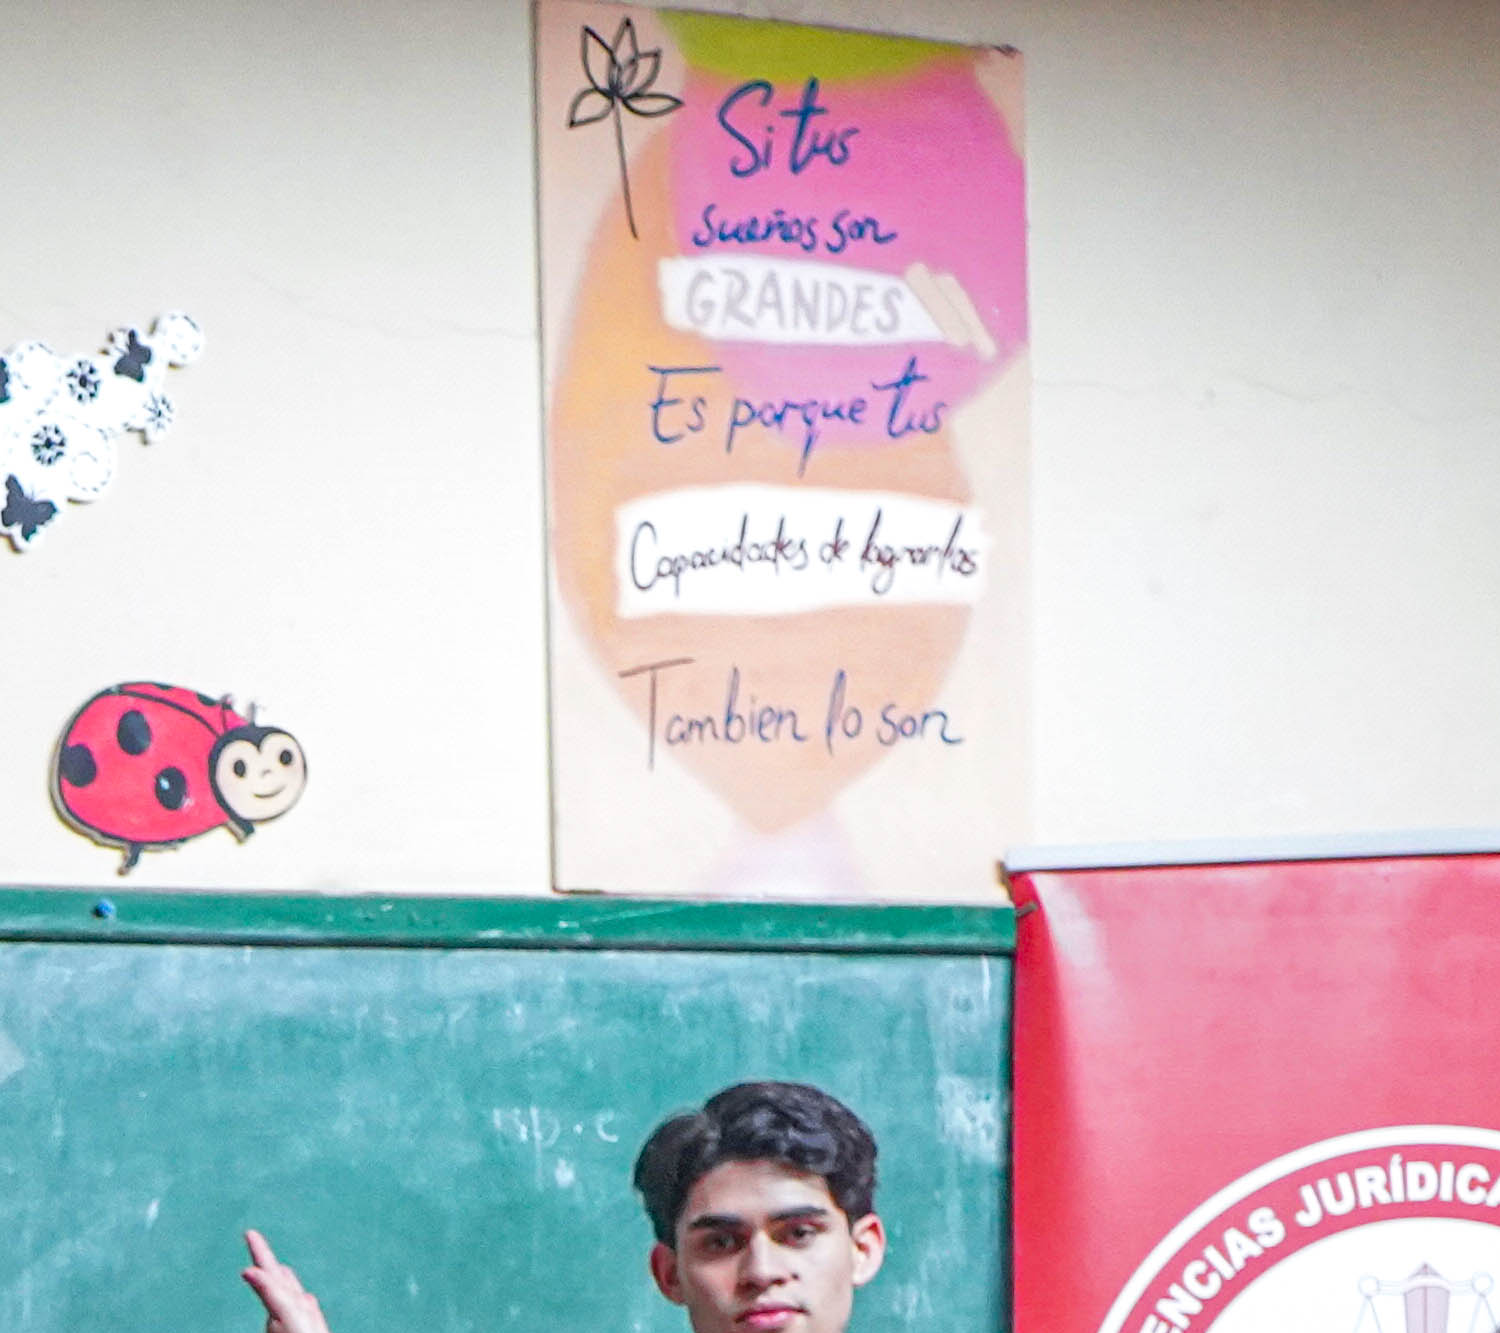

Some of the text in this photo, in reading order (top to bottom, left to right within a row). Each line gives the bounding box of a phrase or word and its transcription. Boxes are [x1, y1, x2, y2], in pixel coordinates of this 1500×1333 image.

[684, 268, 905, 335] GRANDES
[648, 357, 946, 478] Es porque tus
[818, 517, 852, 565] de
[618, 657, 966, 772] Tambien lo son
